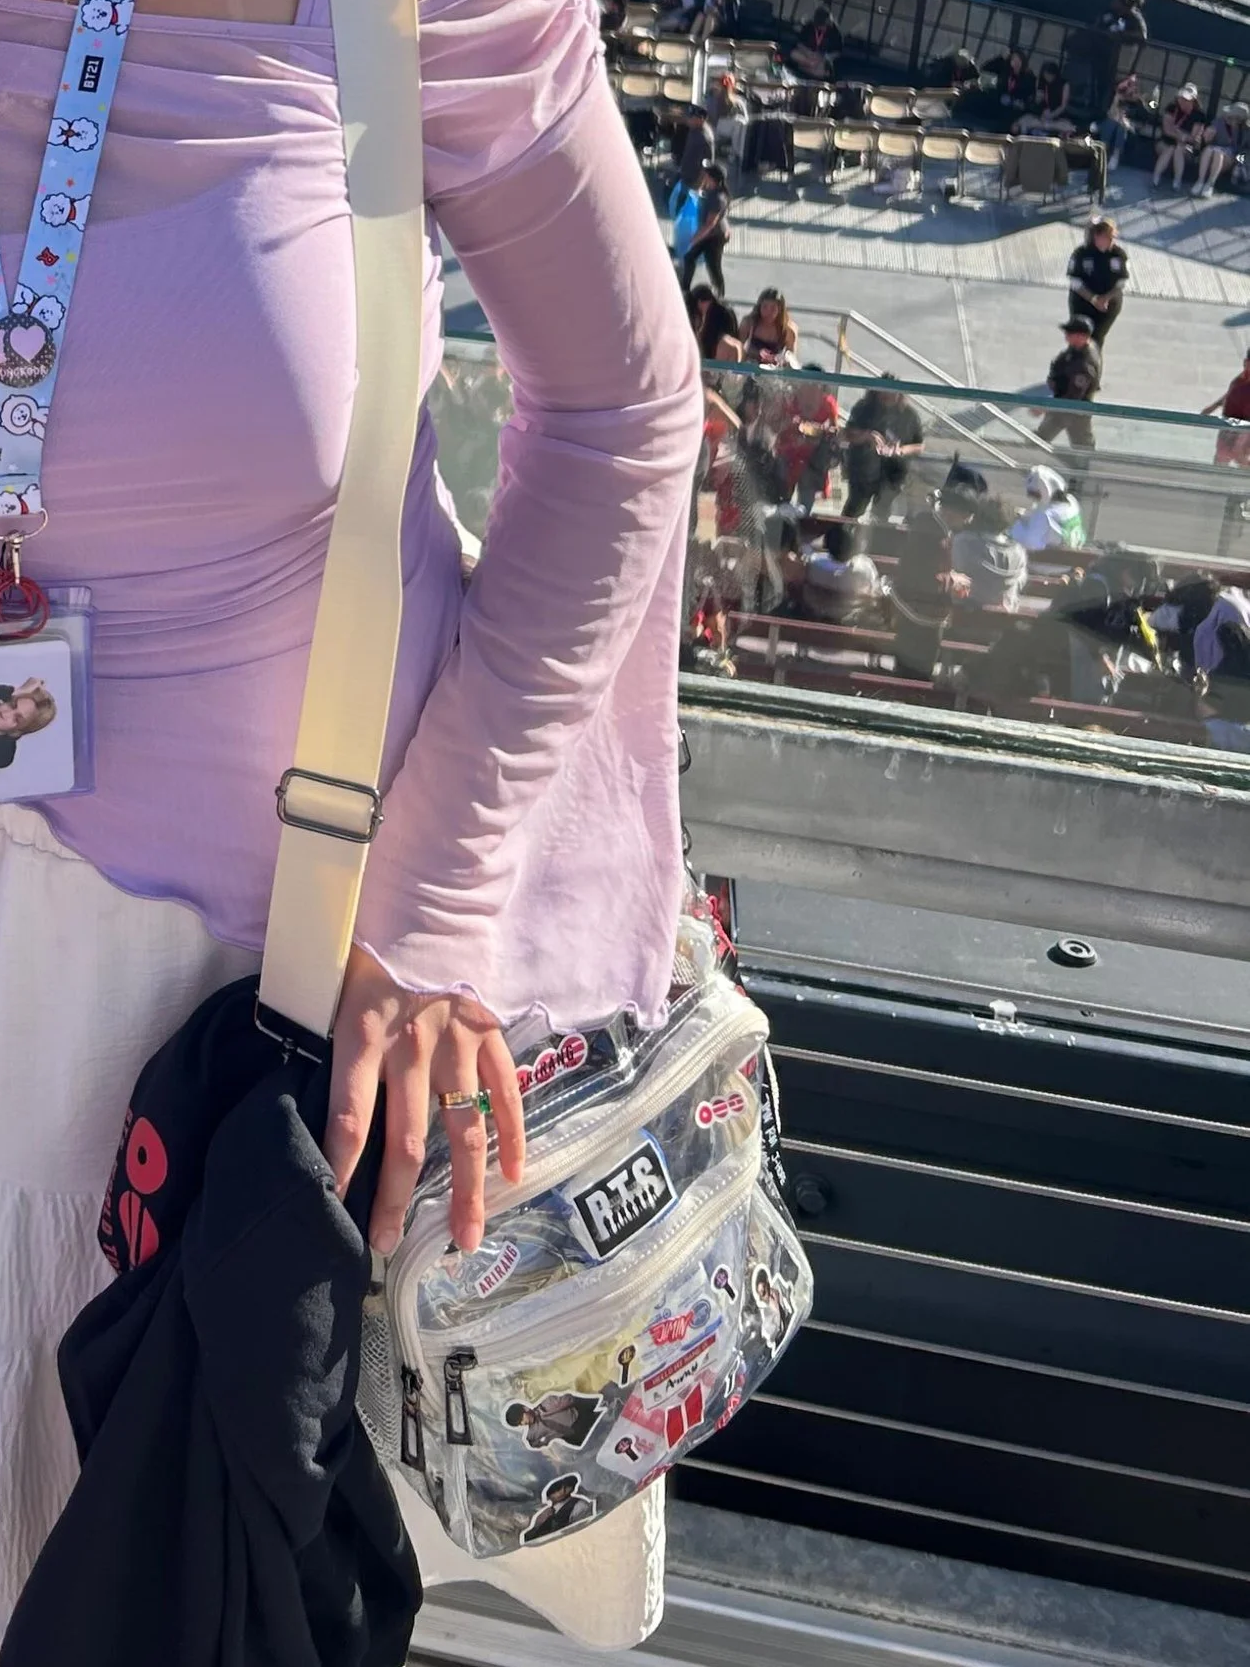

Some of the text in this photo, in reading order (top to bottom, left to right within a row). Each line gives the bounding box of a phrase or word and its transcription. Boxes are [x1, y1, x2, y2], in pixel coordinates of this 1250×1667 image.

[83, 60, 100, 89] BT21
[584, 1156, 667, 1243] BTS
[478, 1245, 518, 1294] ARIRANG
